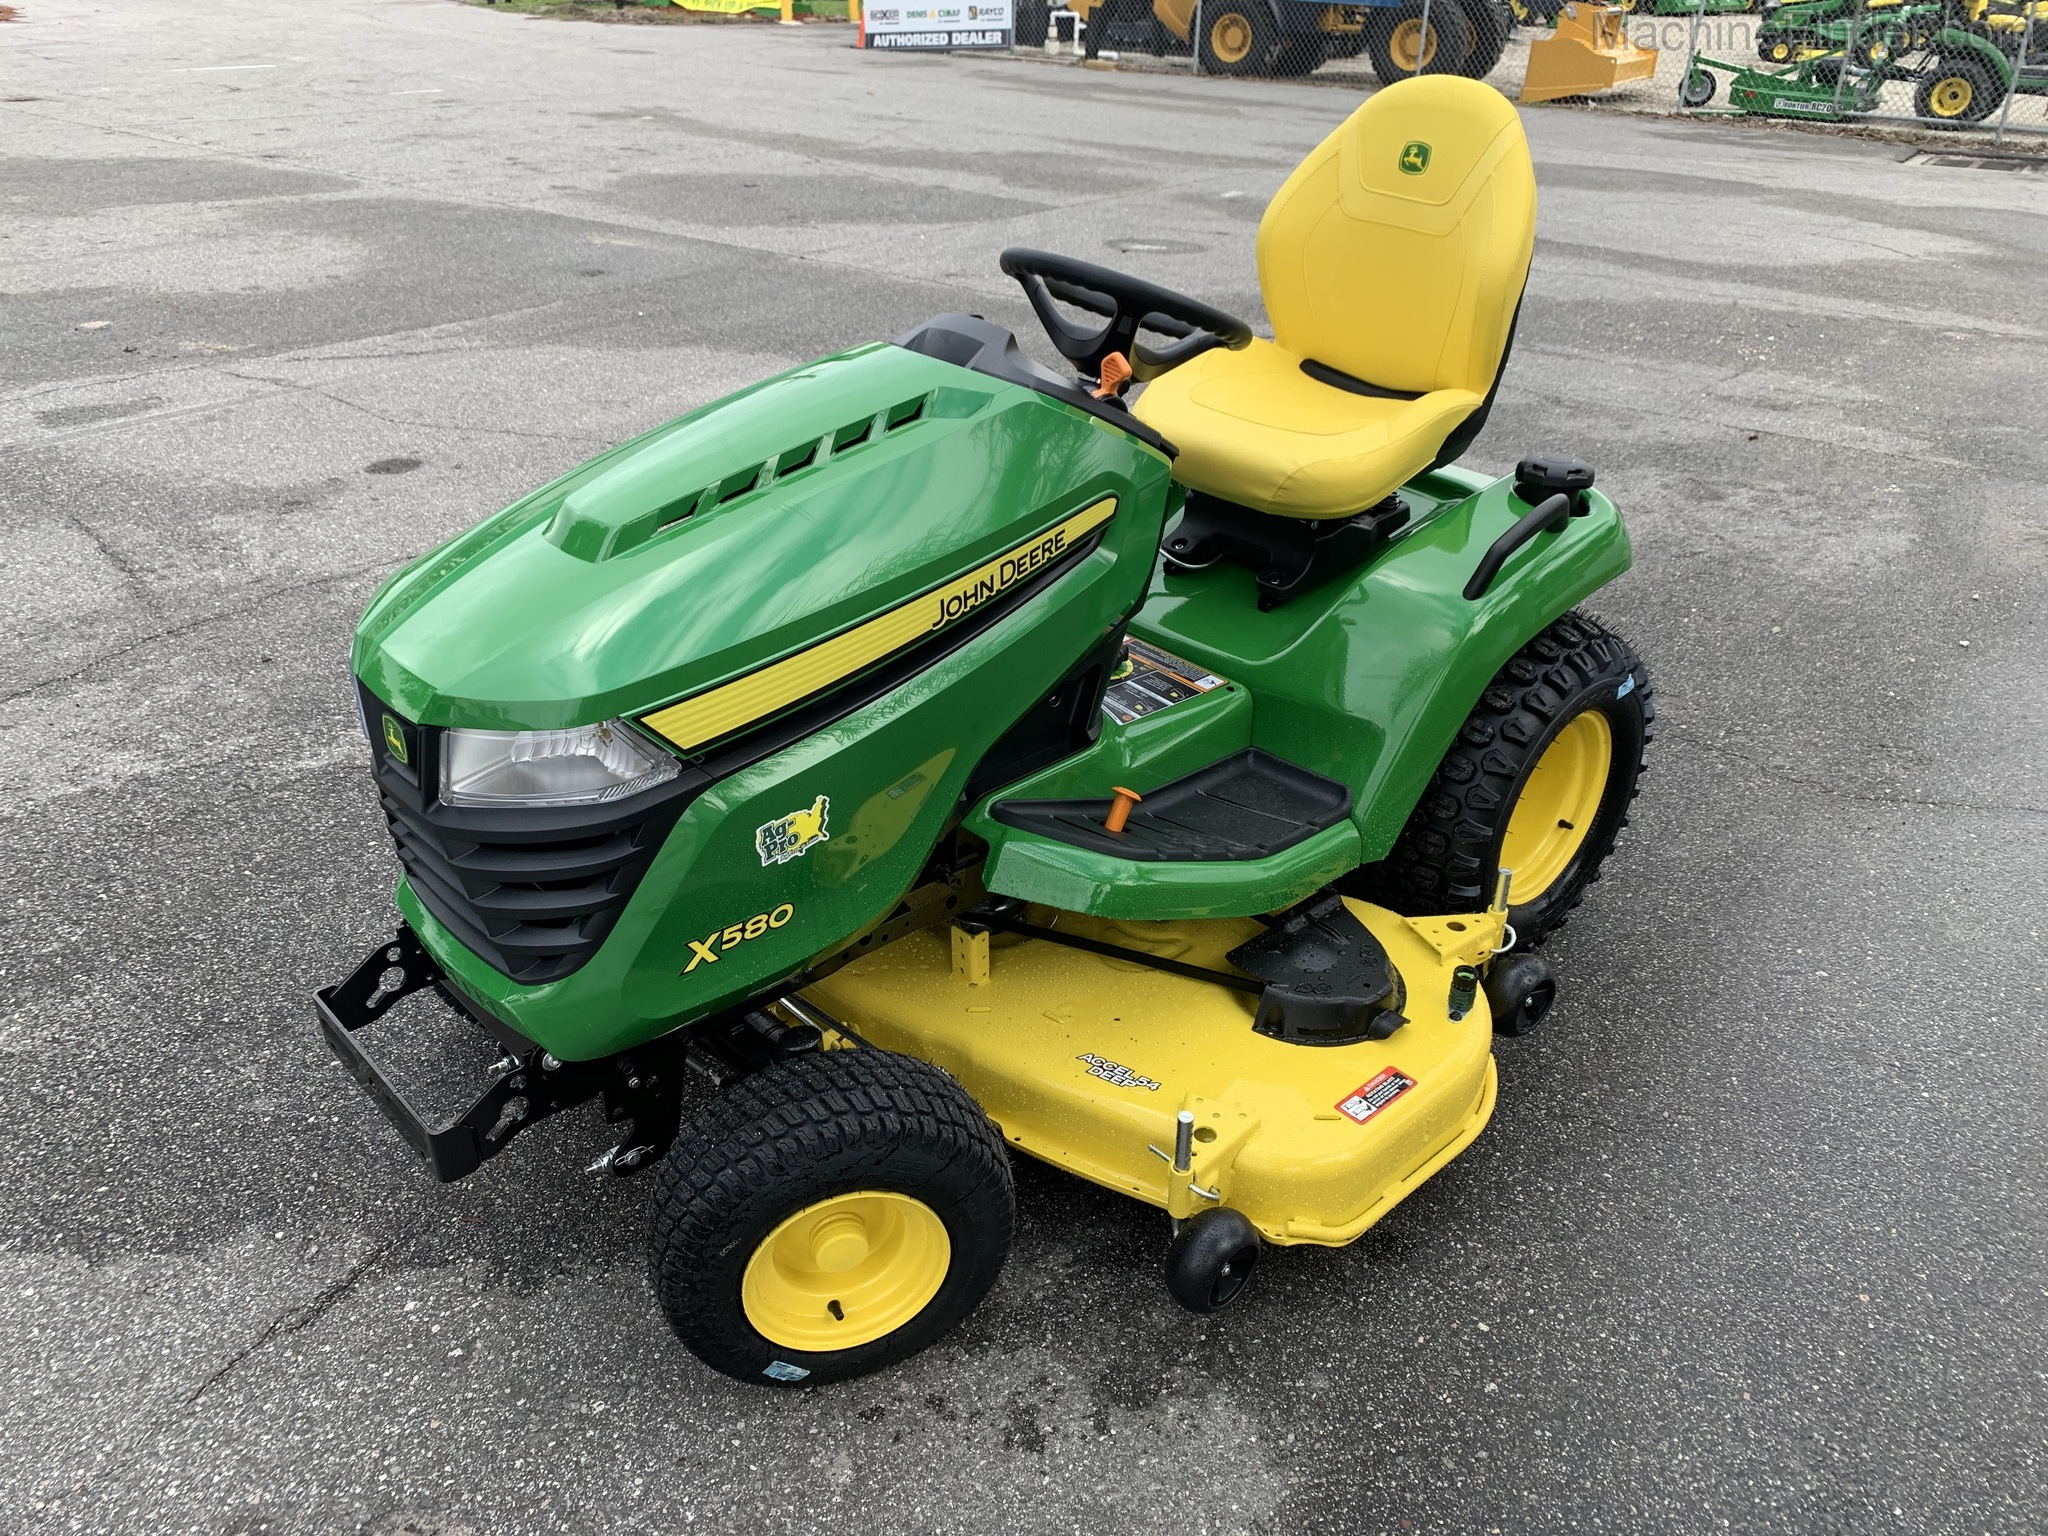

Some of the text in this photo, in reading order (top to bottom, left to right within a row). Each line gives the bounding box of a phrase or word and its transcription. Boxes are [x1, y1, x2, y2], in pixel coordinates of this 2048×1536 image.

[906, 9, 927, 19] DENIS
[978, 7, 1004, 16] RAYCO
[873, 31, 1003, 47] AUTHORIZED DEALER
[931, 529, 1066, 628] JOHN DEERE
[762, 832, 799, 861] Pro
[679, 903, 795, 976] X580
[1075, 1053, 1162, 1091] ACCEL 54
[1086, 1065, 1137, 1087] DEEP
